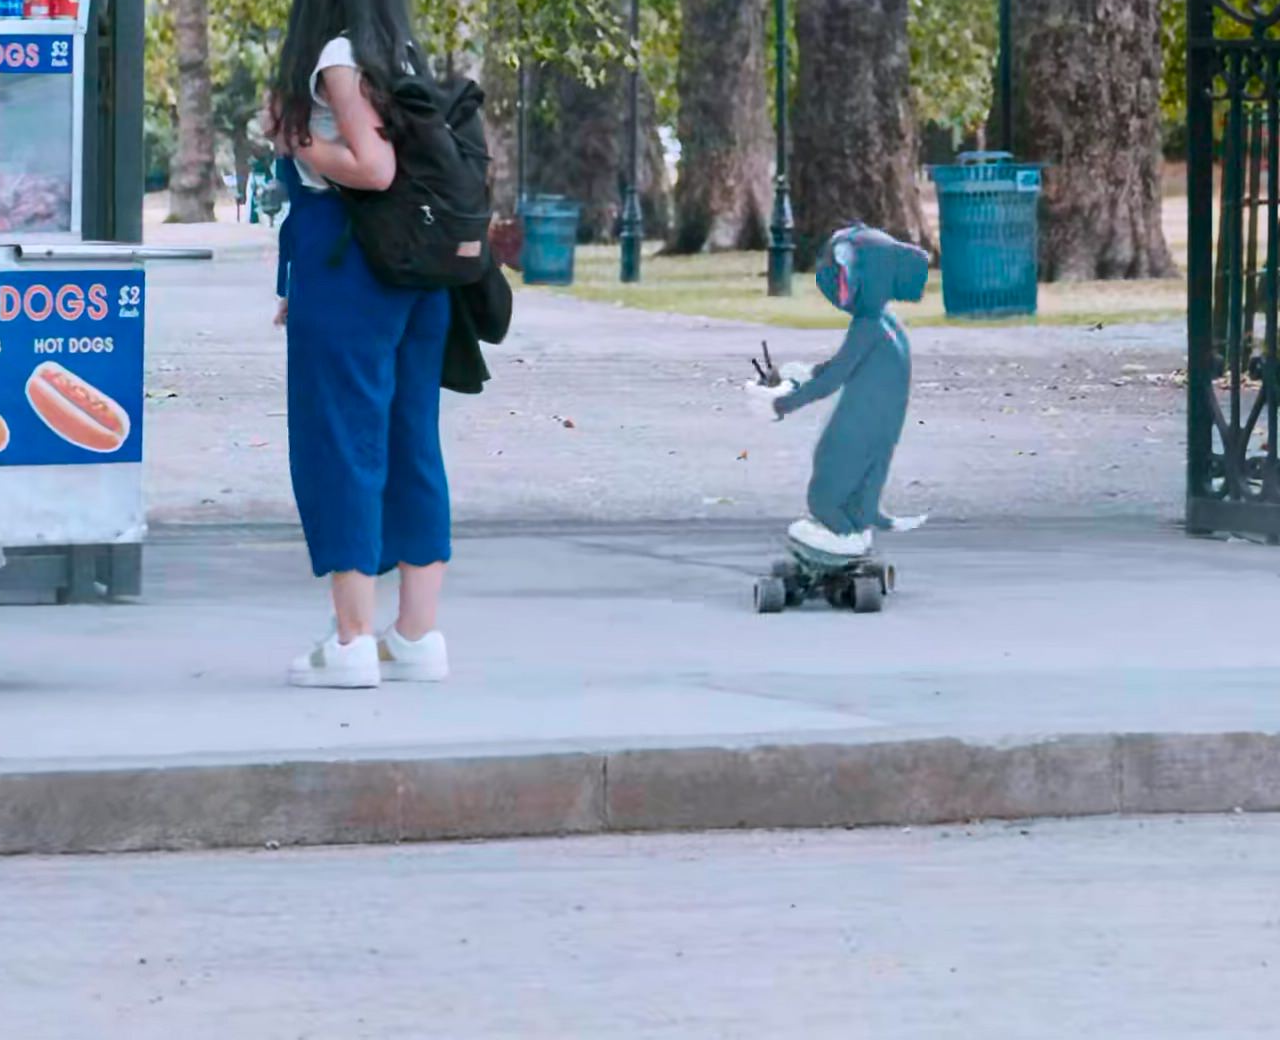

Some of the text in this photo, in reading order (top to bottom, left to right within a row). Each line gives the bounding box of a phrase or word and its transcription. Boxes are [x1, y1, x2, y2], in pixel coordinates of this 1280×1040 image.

[118, 285, 141, 306] $2
[33, 336, 115, 355] HOT DOGS
